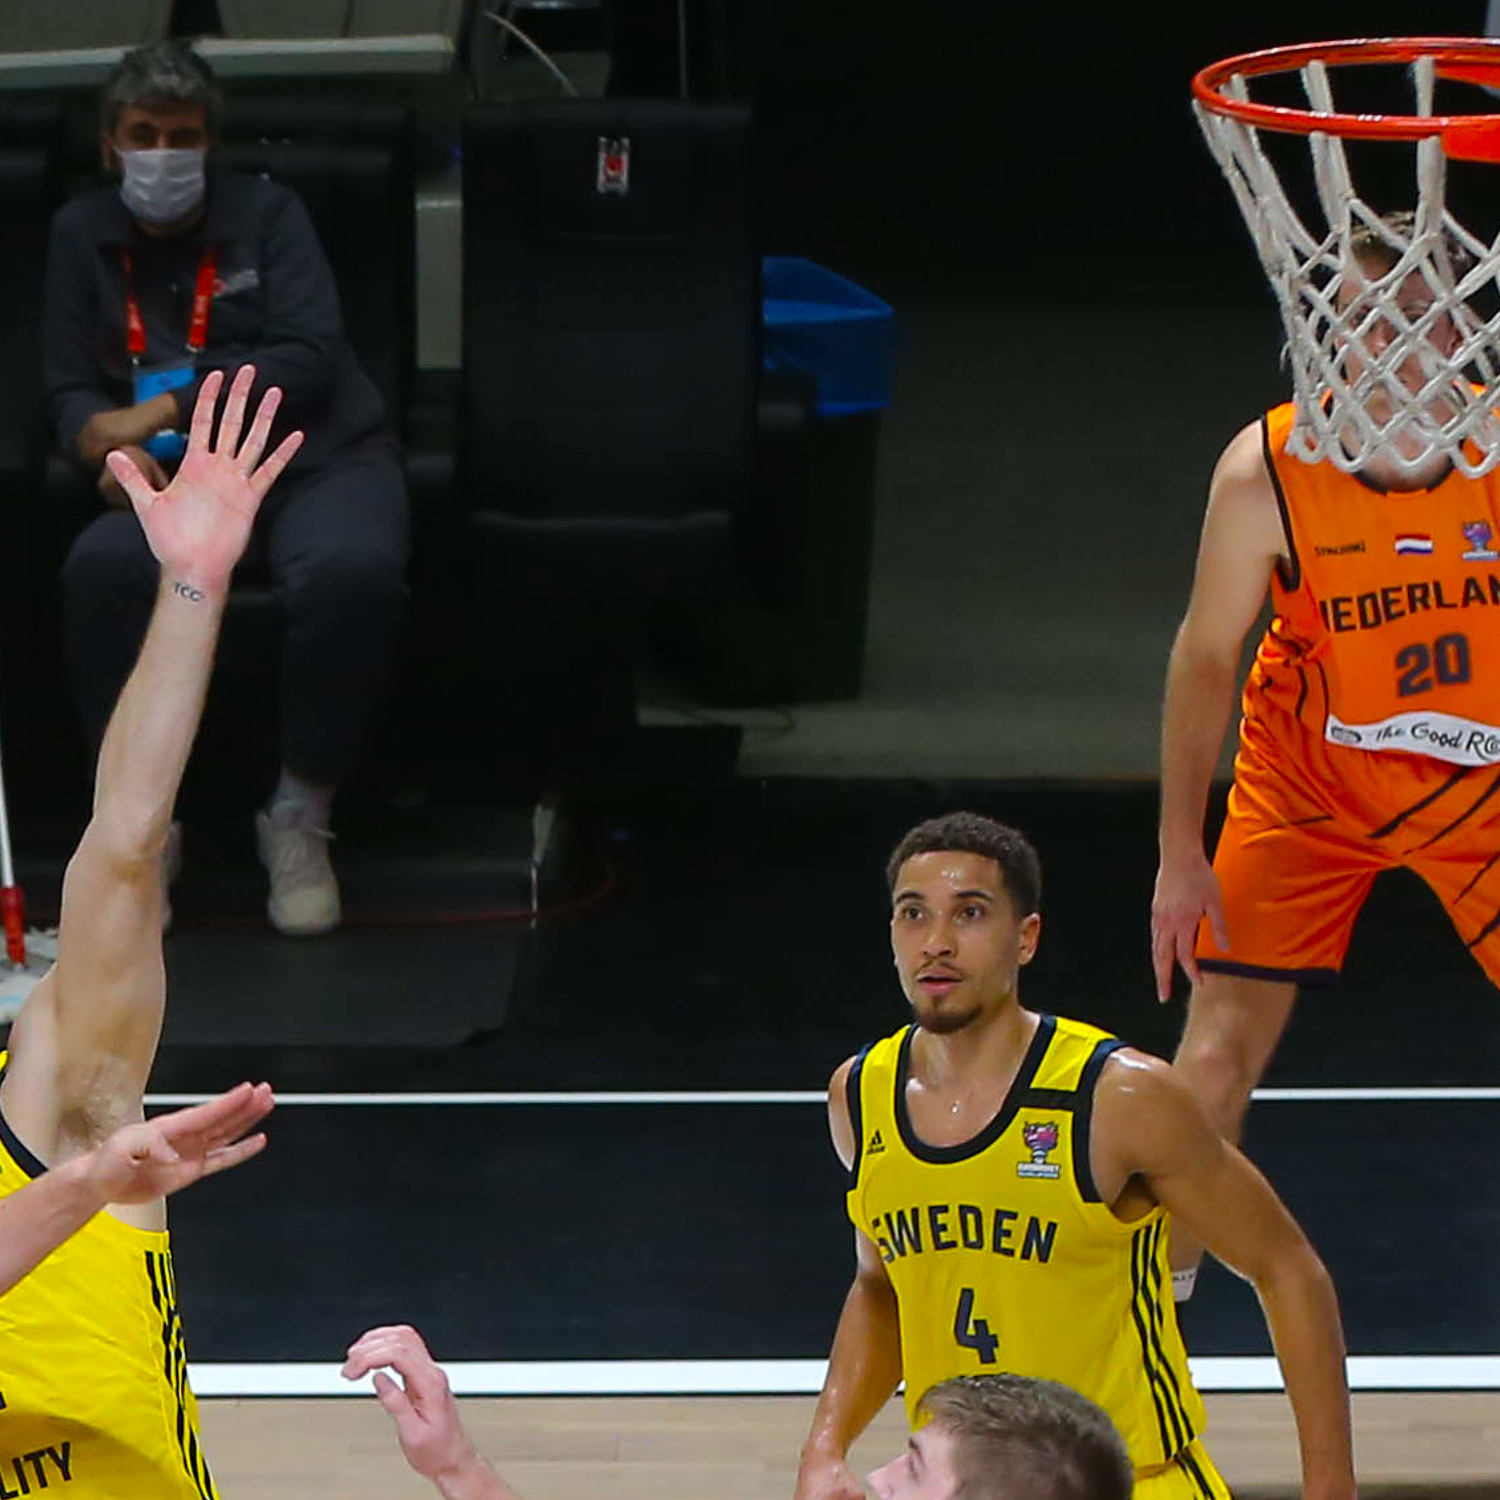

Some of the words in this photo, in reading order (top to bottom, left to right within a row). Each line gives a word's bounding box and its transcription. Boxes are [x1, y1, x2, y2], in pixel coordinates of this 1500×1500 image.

[1396, 633, 1471, 698] 20
[872, 1204, 1057, 1264] SWEDEN
[954, 1287, 999, 1365] 4
